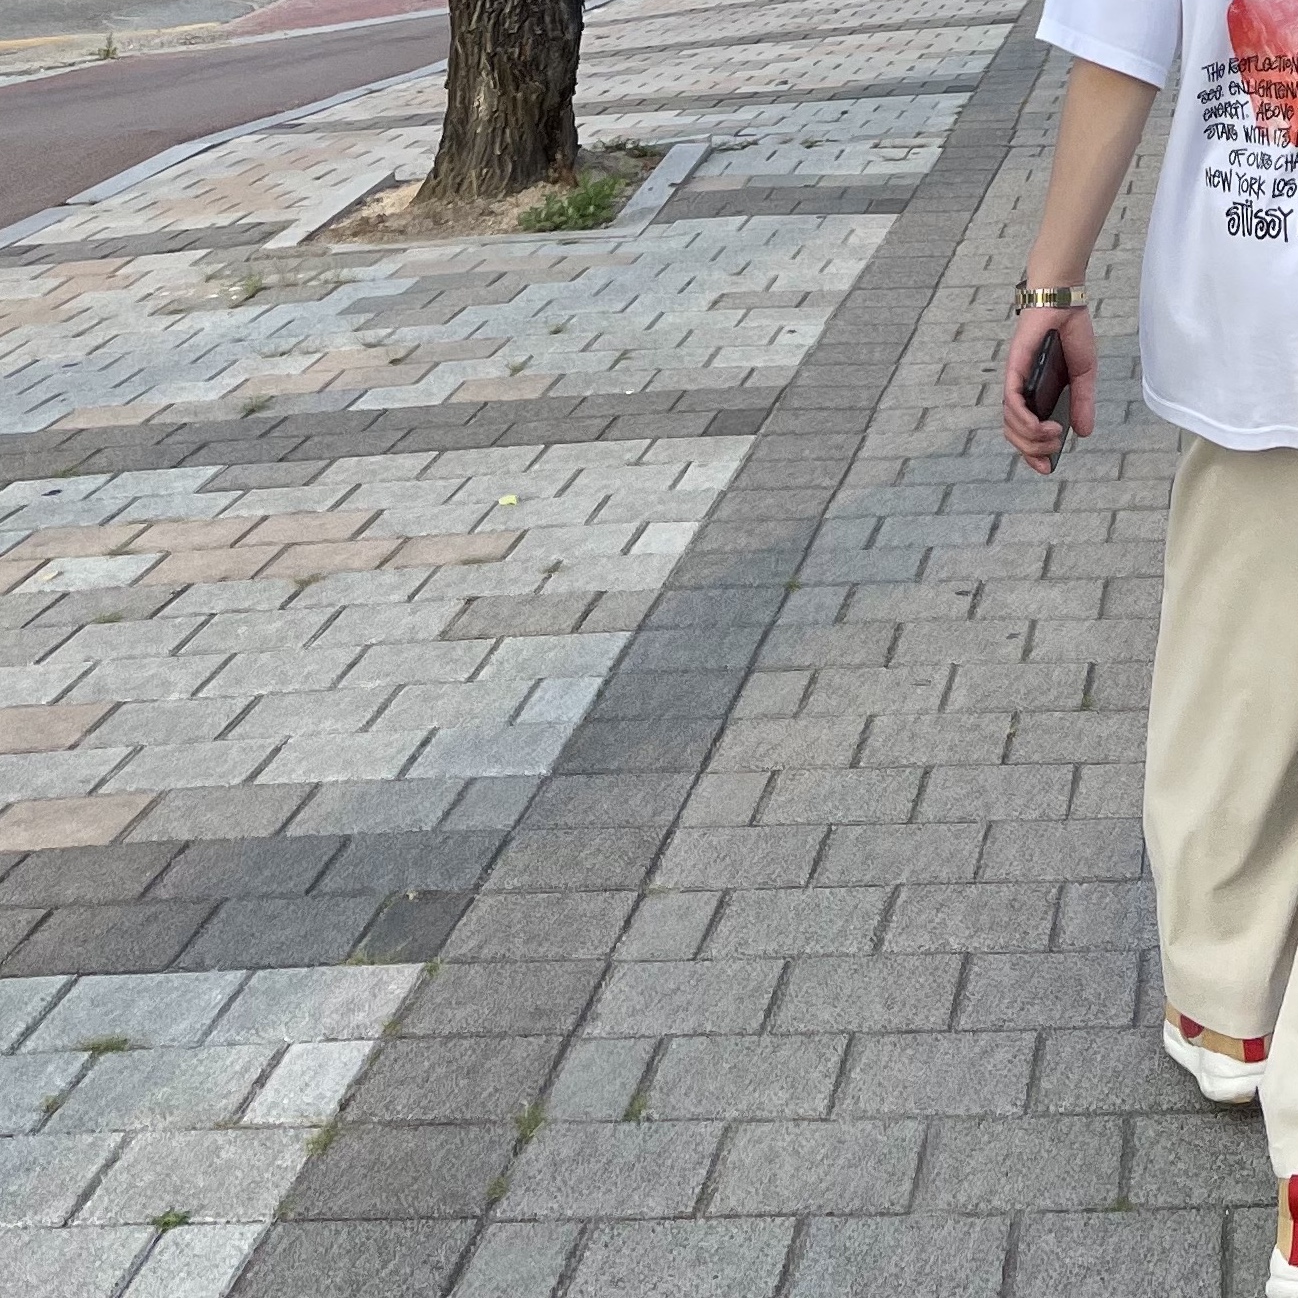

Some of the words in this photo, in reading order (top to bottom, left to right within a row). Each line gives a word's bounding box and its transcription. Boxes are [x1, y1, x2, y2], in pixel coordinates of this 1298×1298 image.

[1243, 124, 1270, 147] WITH
[1228, 147, 1248, 168] OF
[1205, 166, 1233, 194] NEW
[1235, 171, 1267, 200] YORK
[1271, 177, 1298, 199] LOS
